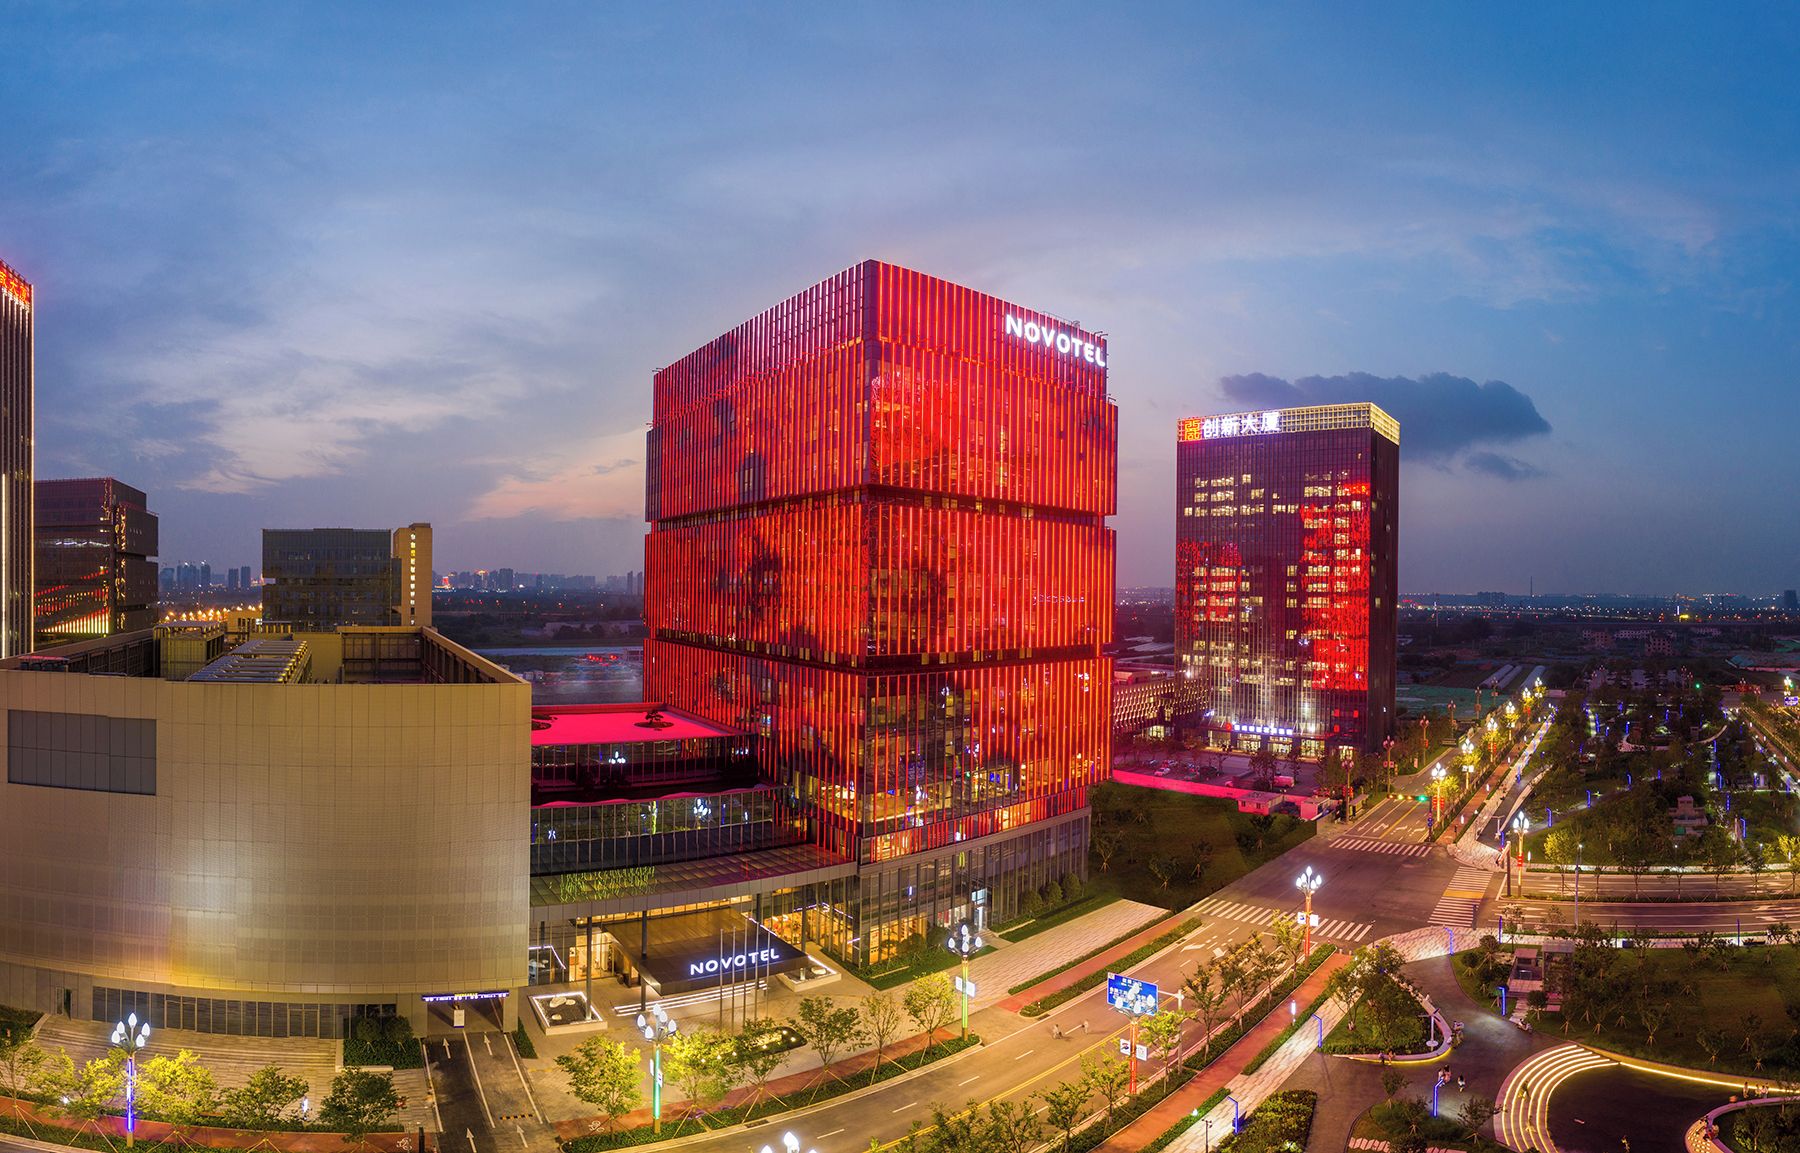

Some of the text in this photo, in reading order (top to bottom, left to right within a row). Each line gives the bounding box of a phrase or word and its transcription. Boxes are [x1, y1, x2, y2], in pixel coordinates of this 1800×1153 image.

[1005, 313, 1106, 367] NOVOTEL
[1202, 411, 1281, 440] 创新大厦
[690, 948, 780, 976] NOVOTEL
